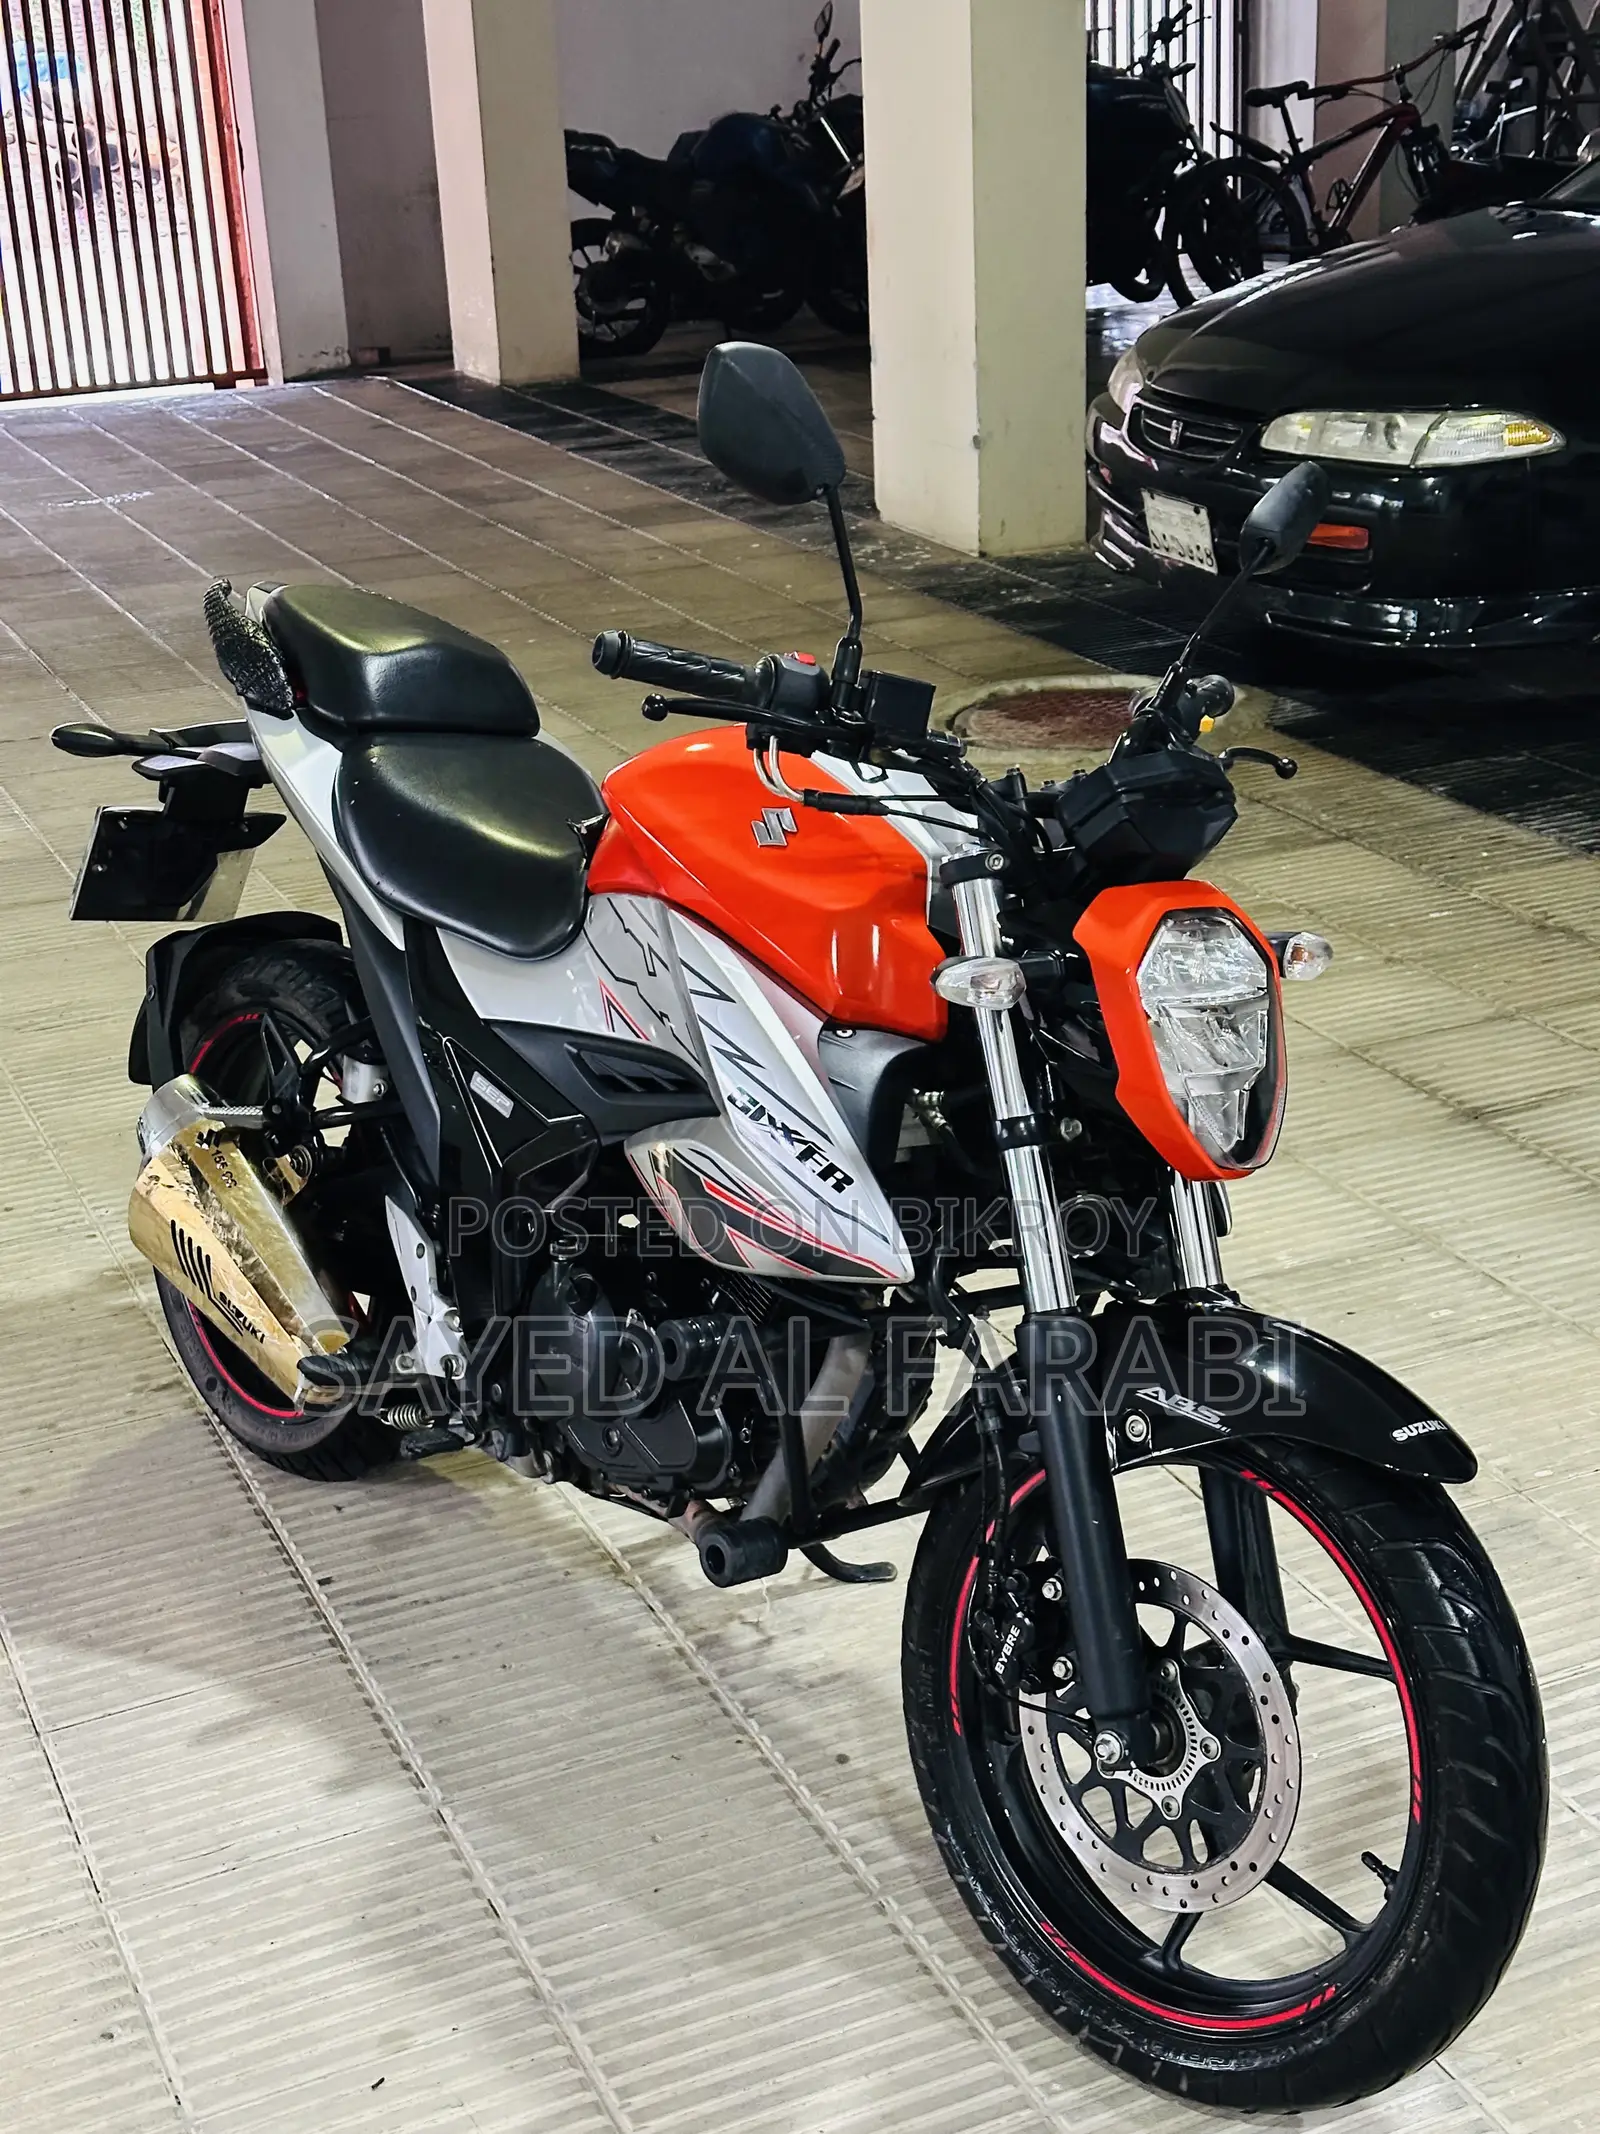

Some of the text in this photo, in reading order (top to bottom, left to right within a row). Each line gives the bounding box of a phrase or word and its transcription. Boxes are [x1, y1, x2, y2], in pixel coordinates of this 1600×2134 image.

[473, 1076, 511, 1108] SEP
[218, 1291, 266, 1345] SUZUKI
[1136, 1386, 1226, 1424] ABS
[1392, 1419, 1448, 1442] SUZUKI
[994, 1624, 1021, 1675] BYBRE
